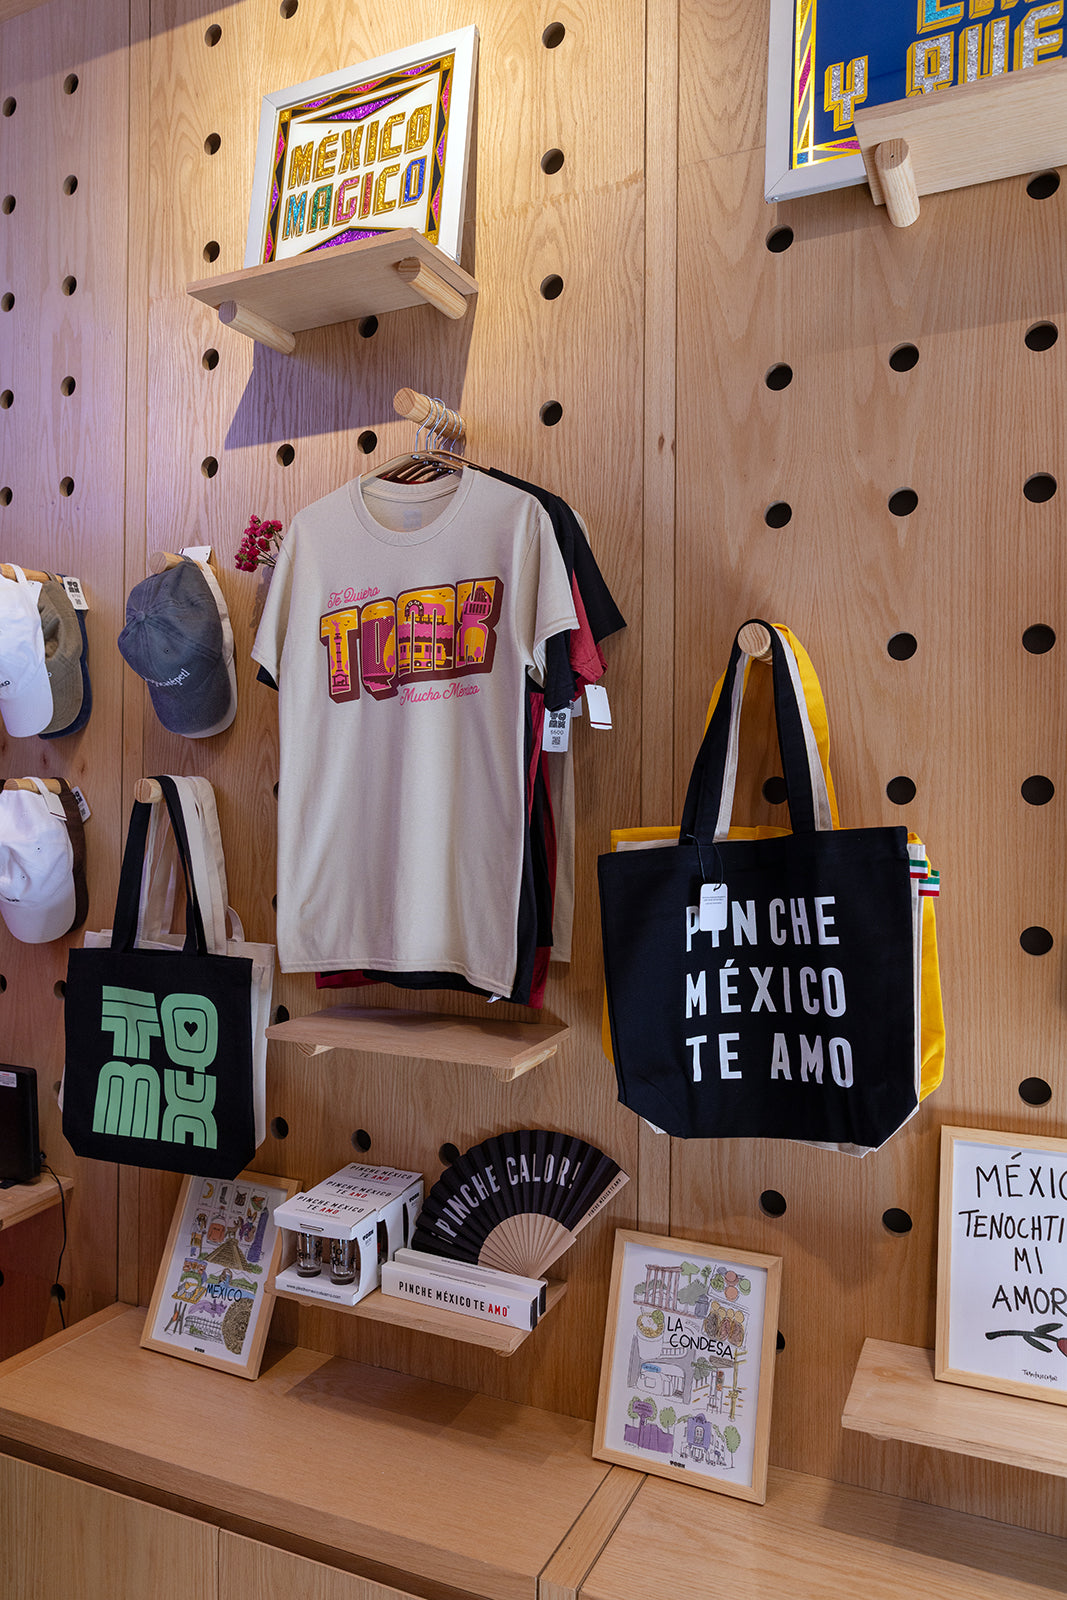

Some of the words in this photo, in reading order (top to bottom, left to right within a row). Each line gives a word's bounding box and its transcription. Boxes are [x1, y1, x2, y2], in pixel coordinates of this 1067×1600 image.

[287, 103, 432, 190] MÉXICO
[282, 155, 427, 241] MAGICO
[343, 585, 380, 604] Quiero
[400, 687, 441, 706] Mucho
[685, 958, 847, 1019] MÉXICO
[685, 1032, 742, 1082] TE
[770, 1032, 854, 1088] AMO
[326, 1181, 358, 1190] PINCHE
[506, 1152, 582, 1190] CALOR!
[296, 1195, 330, 1206] PINCHE
[319, 1207, 339, 1215] AMO
[958, 1209, 1064, 1243] TENOCHTI
[1014, 1247, 1043, 1275] MI
[399, 1281, 432, 1299] PINCHE
[436, 1290, 471, 1308] MÉXICO
[473, 1299, 485, 1312] TE
[487, 1303, 508, 1318] AMO
[991, 1284, 1067, 1317] AMOR
[667, 1316, 684, 1332] LA
